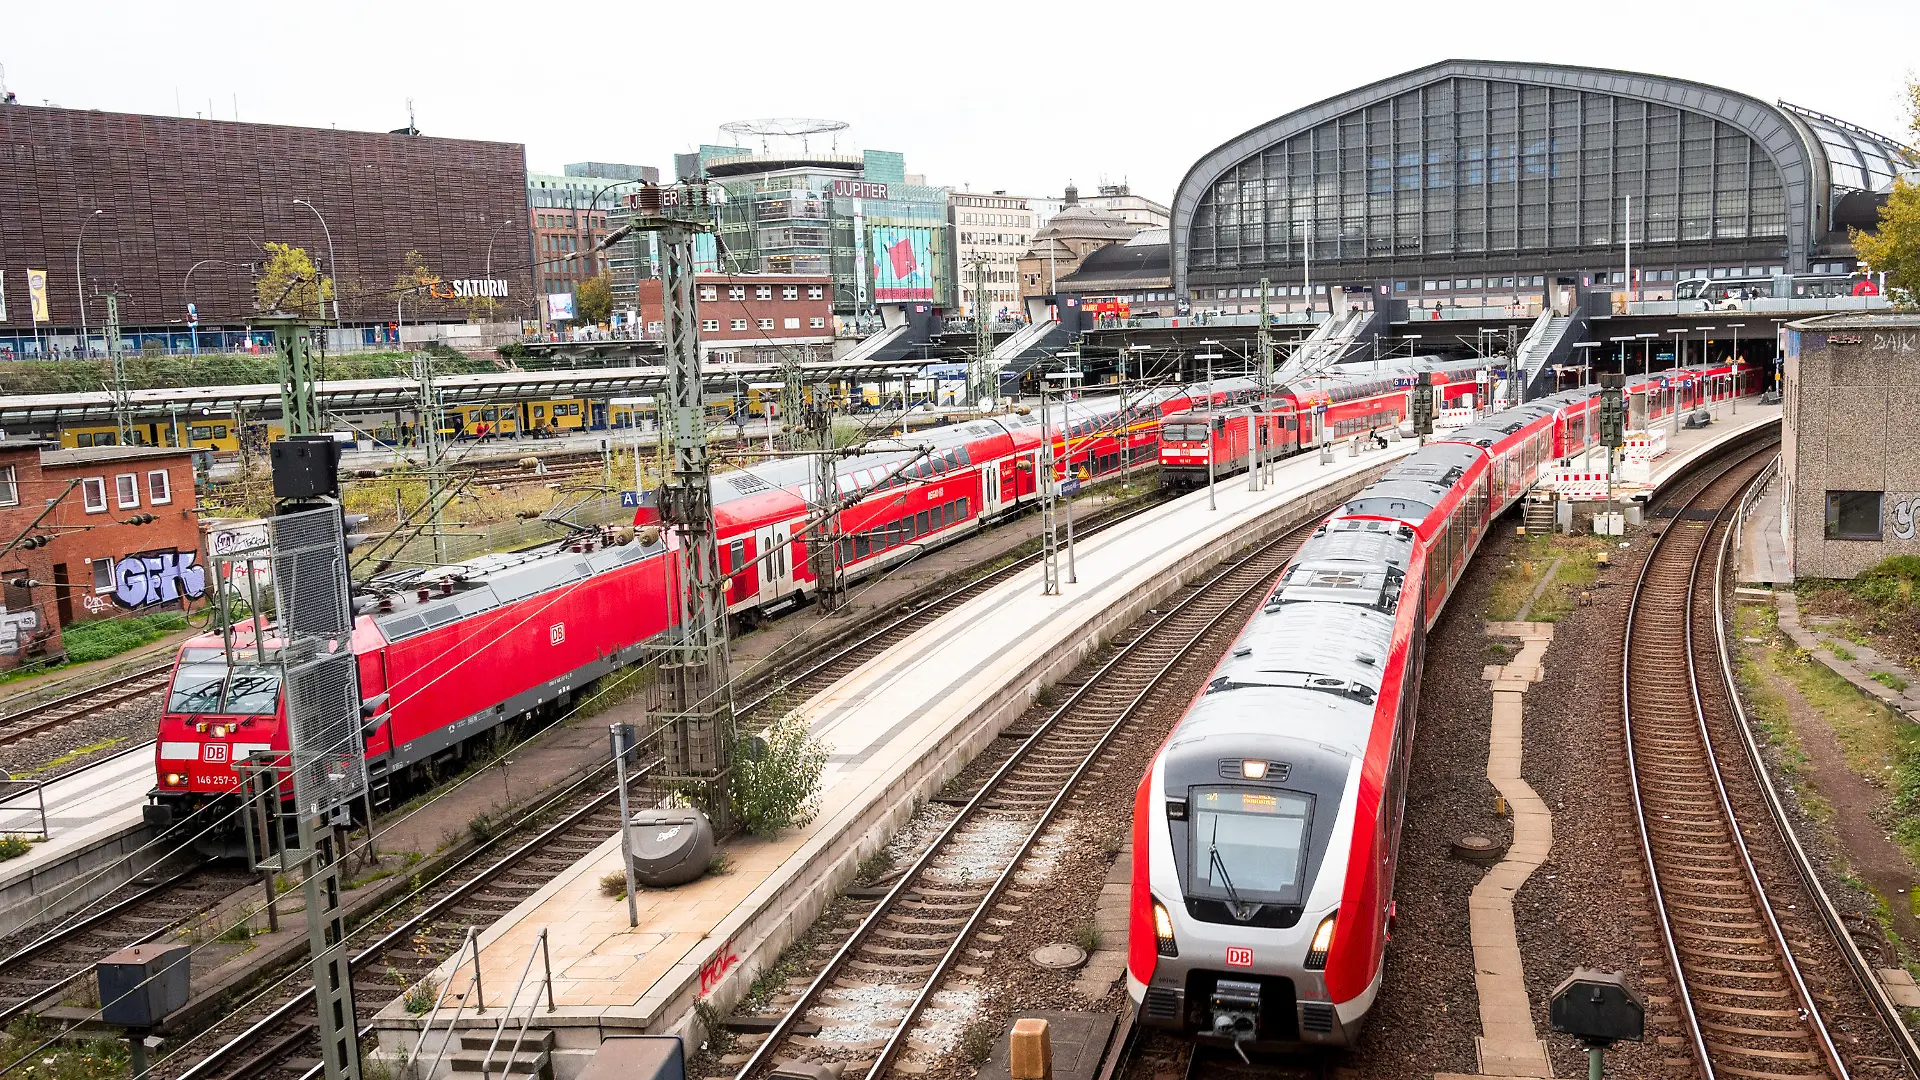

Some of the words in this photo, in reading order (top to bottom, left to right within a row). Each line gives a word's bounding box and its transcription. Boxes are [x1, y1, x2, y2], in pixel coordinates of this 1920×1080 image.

[836, 181, 887, 199] JUPITER
[452, 279, 508, 297] SATURN
[1660, 379, 1666, 387] 4
[624, 492, 634, 505] A
[552, 625, 564, 643] DB
[206, 747, 226, 761] DB
[196, 775, 211, 785] 146
[213, 775, 238, 785] 257-3
[1228, 949, 1250, 965] DB
